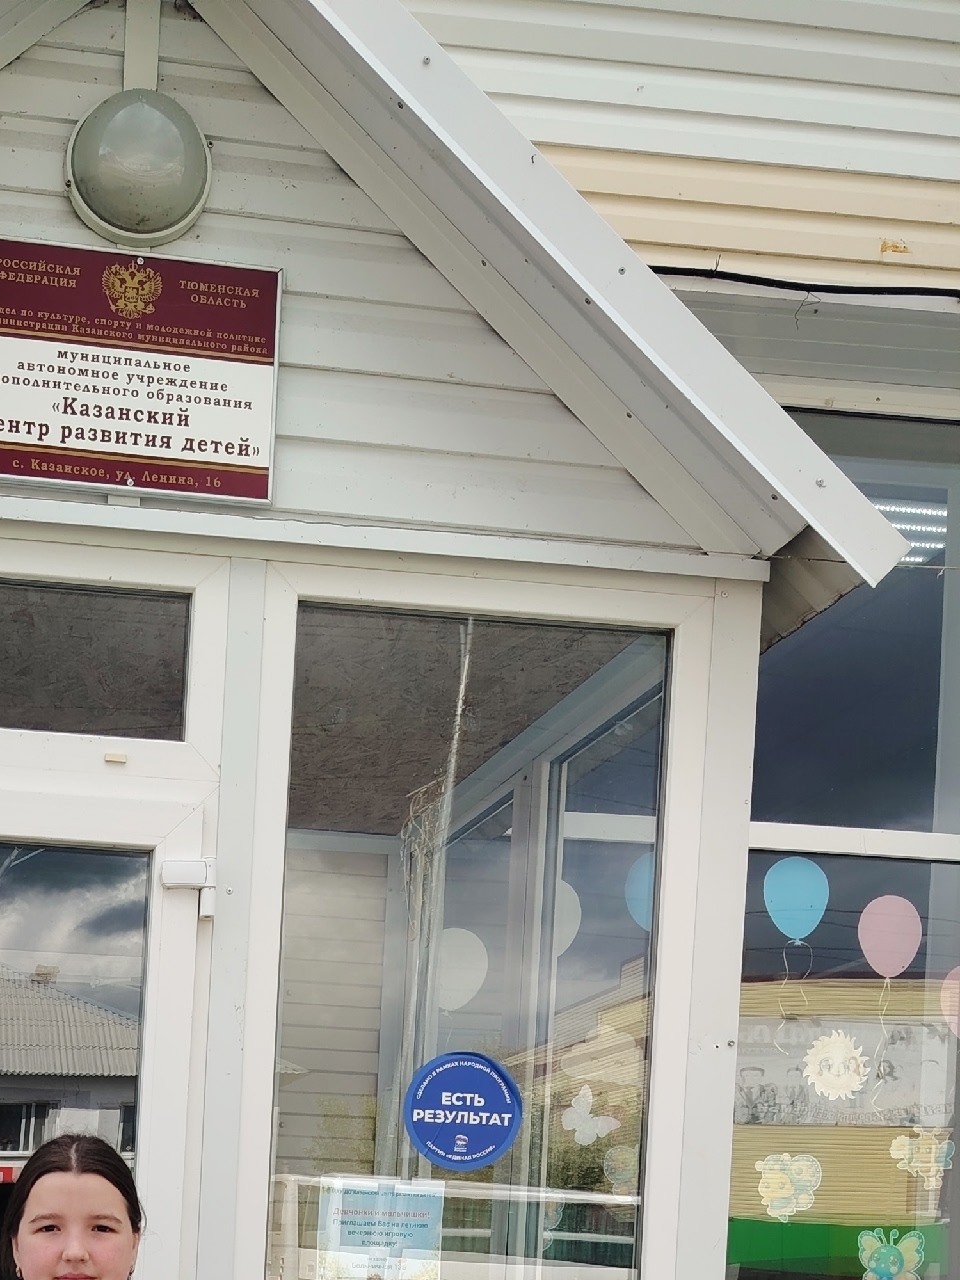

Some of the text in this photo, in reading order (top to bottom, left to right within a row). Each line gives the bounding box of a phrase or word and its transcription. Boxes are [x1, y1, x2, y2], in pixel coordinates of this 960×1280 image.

[179, 280, 260, 298] ТЮМЕНСКАЯ
[190, 294, 247, 309] ОБЛАСТЬ
[20, 308, 33, 318] по
[37, 311, 90, 325] культуре,
[94, 317, 132, 330] спорту
[135, 321, 142, 329] и
[146, 324, 213, 339] молодежной
[216, 332, 267, 345] политике
[71, 324, 133, 340] Казанского
[138, 334, 228, 351] муниципального
[231, 343, 268, 355] района
[56, 350, 191, 373] муниципальное
[16, 360, 228, 392] автономное учреждение
[52, 397, 190, 427] «Казанский
[146, 389, 253, 410] образования
[60, 424, 172, 449] развития
[180, 437, 261, 457] детей»
[12, 459, 24, 469] с.
[31, 458, 110, 479] Казанское,
[141, 471, 198, 487] Ленина,
[205, 476, 221, 488] 16
[459, 1061, 491, 1074] НАРОДНОЙ
[489, 1069, 512, 1104] ПРОГРАММЫ
[441, 1091, 485, 1107] ЕСТЬ
[412, 1108, 512, 1127] РЕЗУЛЬТАТ
[381, 1210, 430, 1219] мальчишки!
